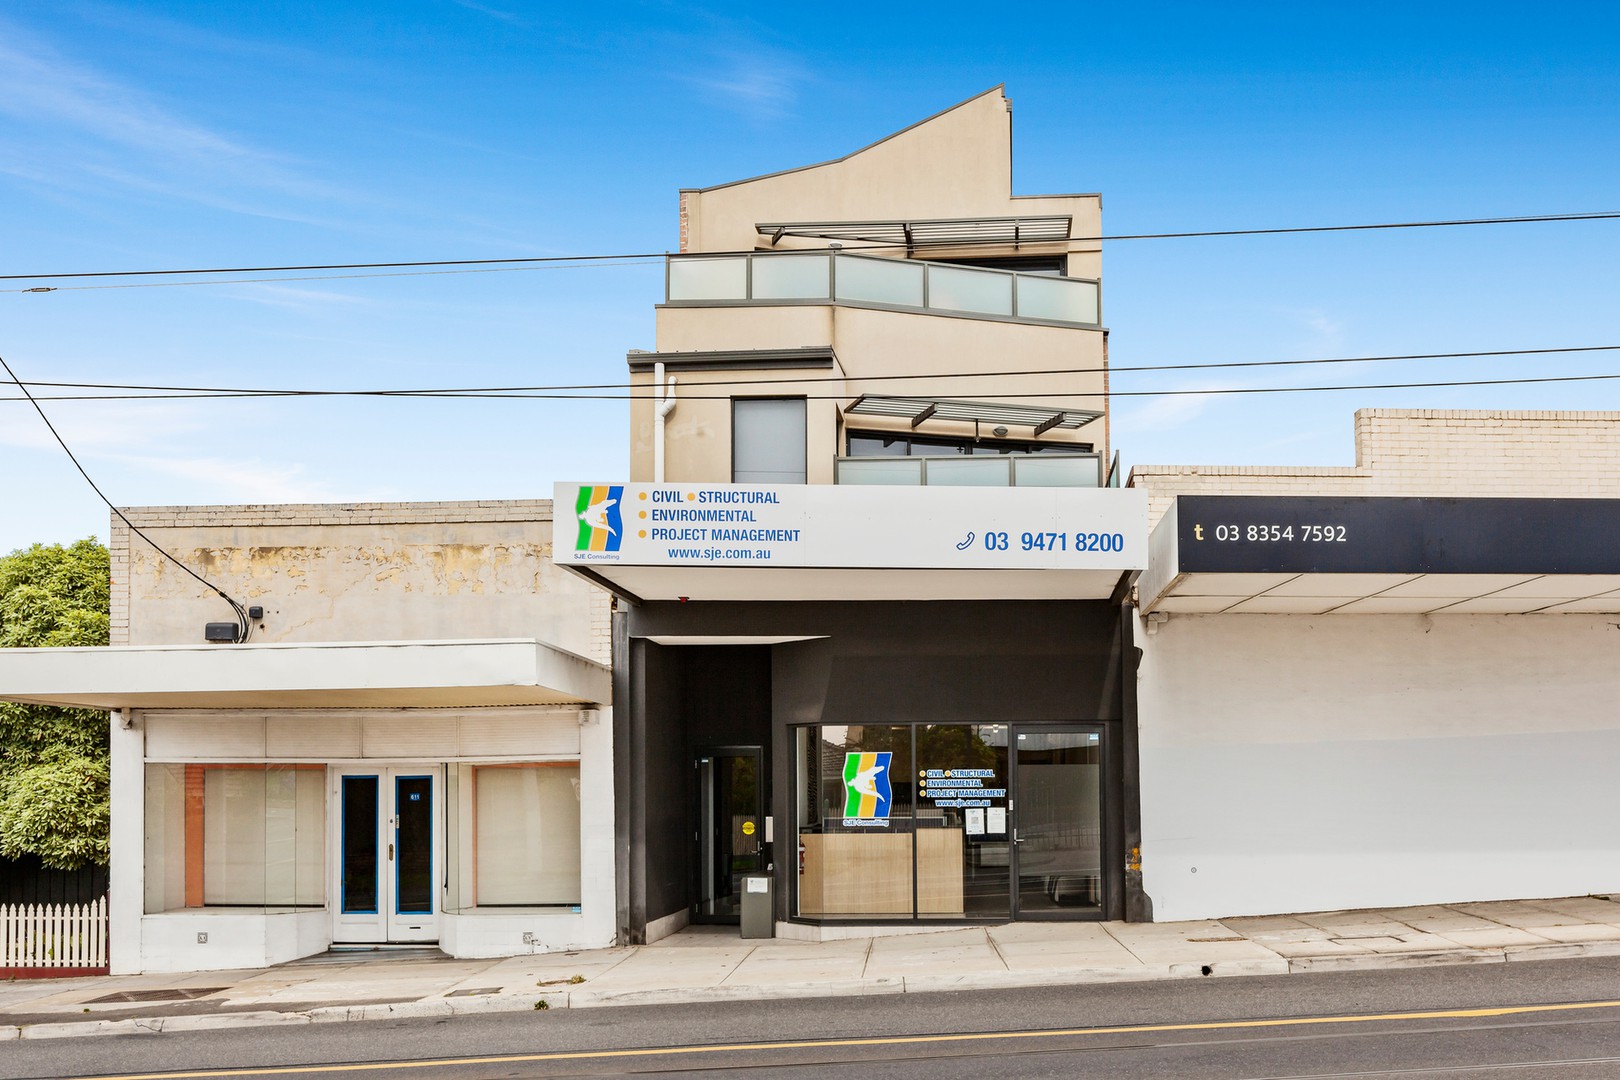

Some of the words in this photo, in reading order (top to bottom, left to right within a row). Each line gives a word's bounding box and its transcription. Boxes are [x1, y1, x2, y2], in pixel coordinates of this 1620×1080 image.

[652, 491, 684, 503] CIVIL
[698, 491, 780, 504] STRUCTURAL
[652, 509, 757, 522] ENVIRONMENTAL
[652, 528, 707, 541] PROJECT
[712, 529, 801, 542] MANAGEMENT
[1194, 524, 1204, 541] t
[1215, 525, 1240, 541] 03
[1247, 525, 1294, 541] 8354
[1301, 525, 1347, 542] 7592
[984, 531, 1009, 551] 03
[1021, 532, 1067, 551] 9471
[1075, 533, 1124, 552] 8200
[668, 547, 771, 560] www.sje.com.au
[927, 769, 945, 777] CIVIL
[951, 769, 994, 777] STRUCTURAL
[927, 779, 983, 787] ENVIRONMENTAL
[927, 789, 957, 797] PROJECT
[958, 789, 1005, 797] MANAGEMENT
[936, 799, 991, 807] www.sje.com.au
[857, 819, 889, 827] Consulting
